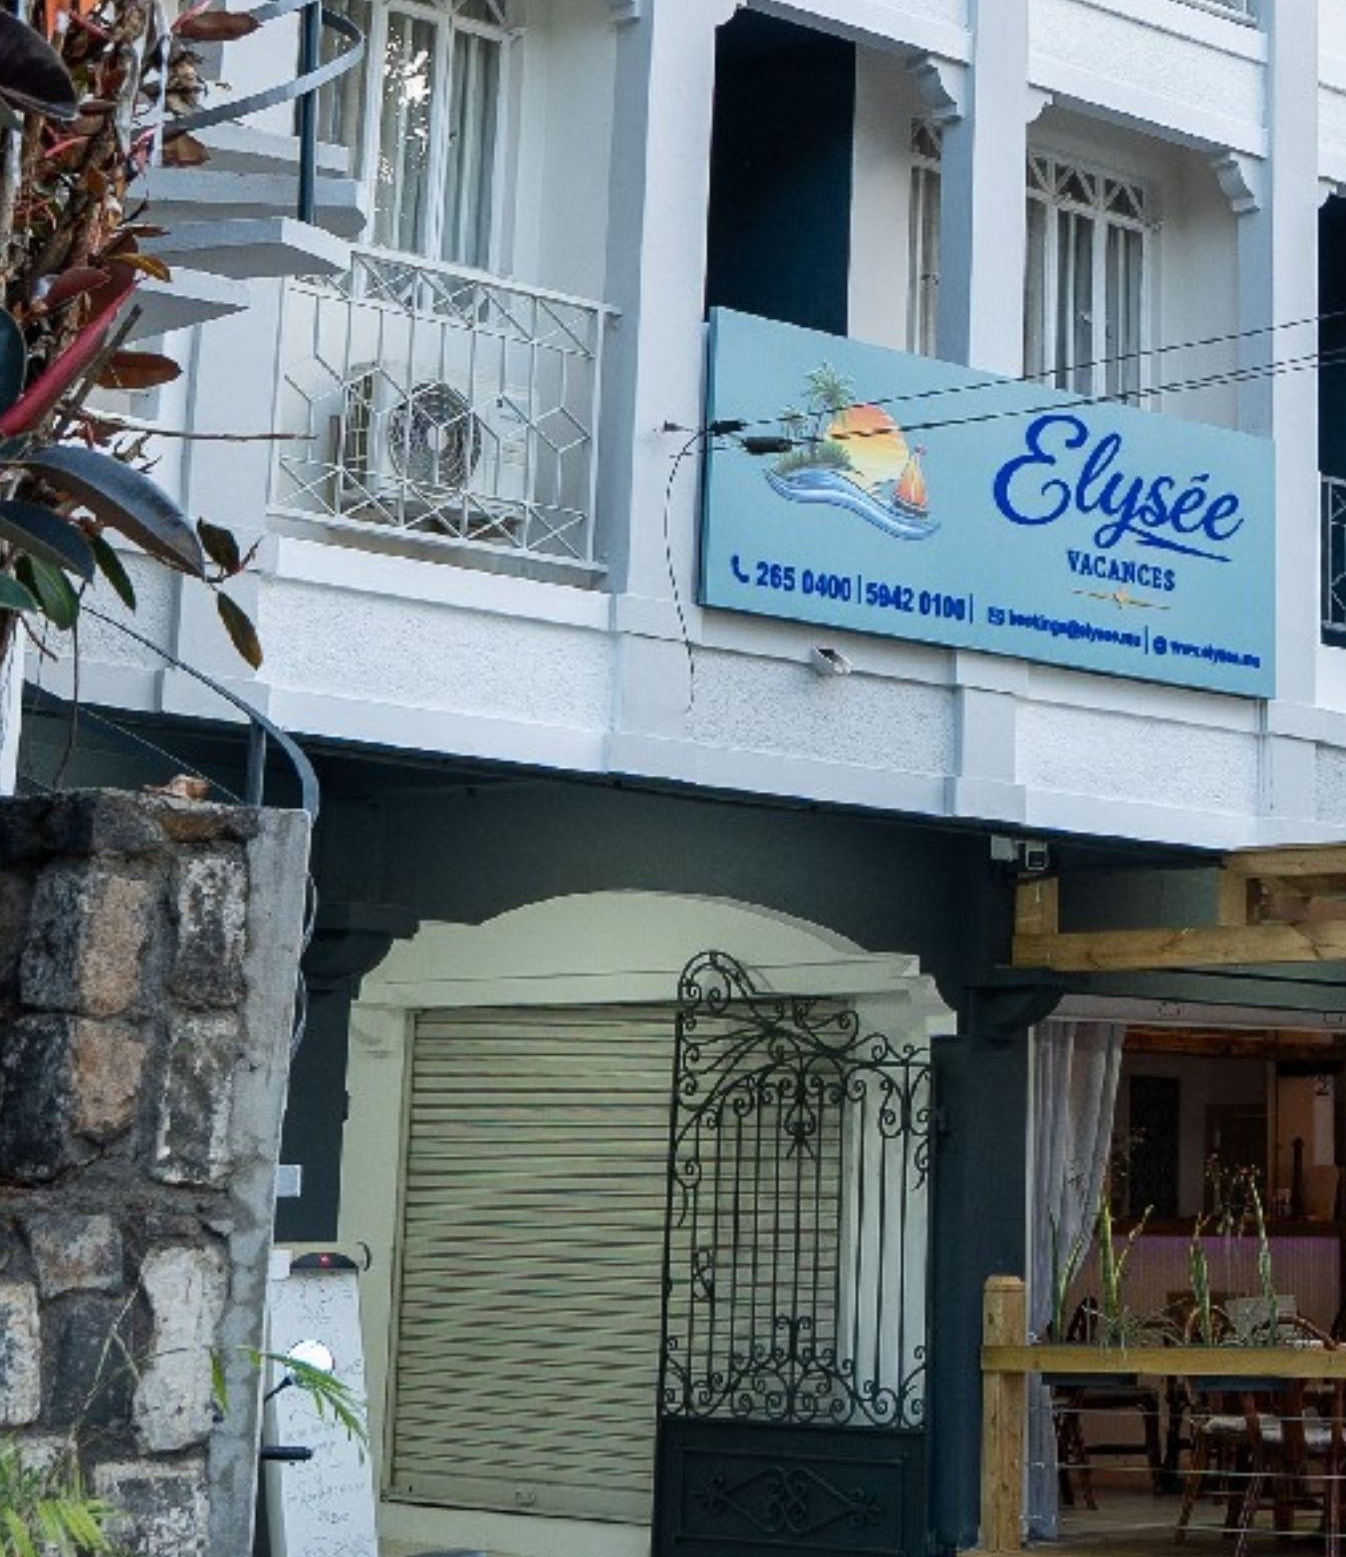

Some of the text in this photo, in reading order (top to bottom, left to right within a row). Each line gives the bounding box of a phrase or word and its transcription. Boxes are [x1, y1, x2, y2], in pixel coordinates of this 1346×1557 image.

[993, 414, 1244, 549] Elysée
[756, 561, 796, 591] 265
[802, 569, 851, 601] 0400
[865, 582, 914, 613] 5942
[1067, 549, 1176, 591] VACANCES
